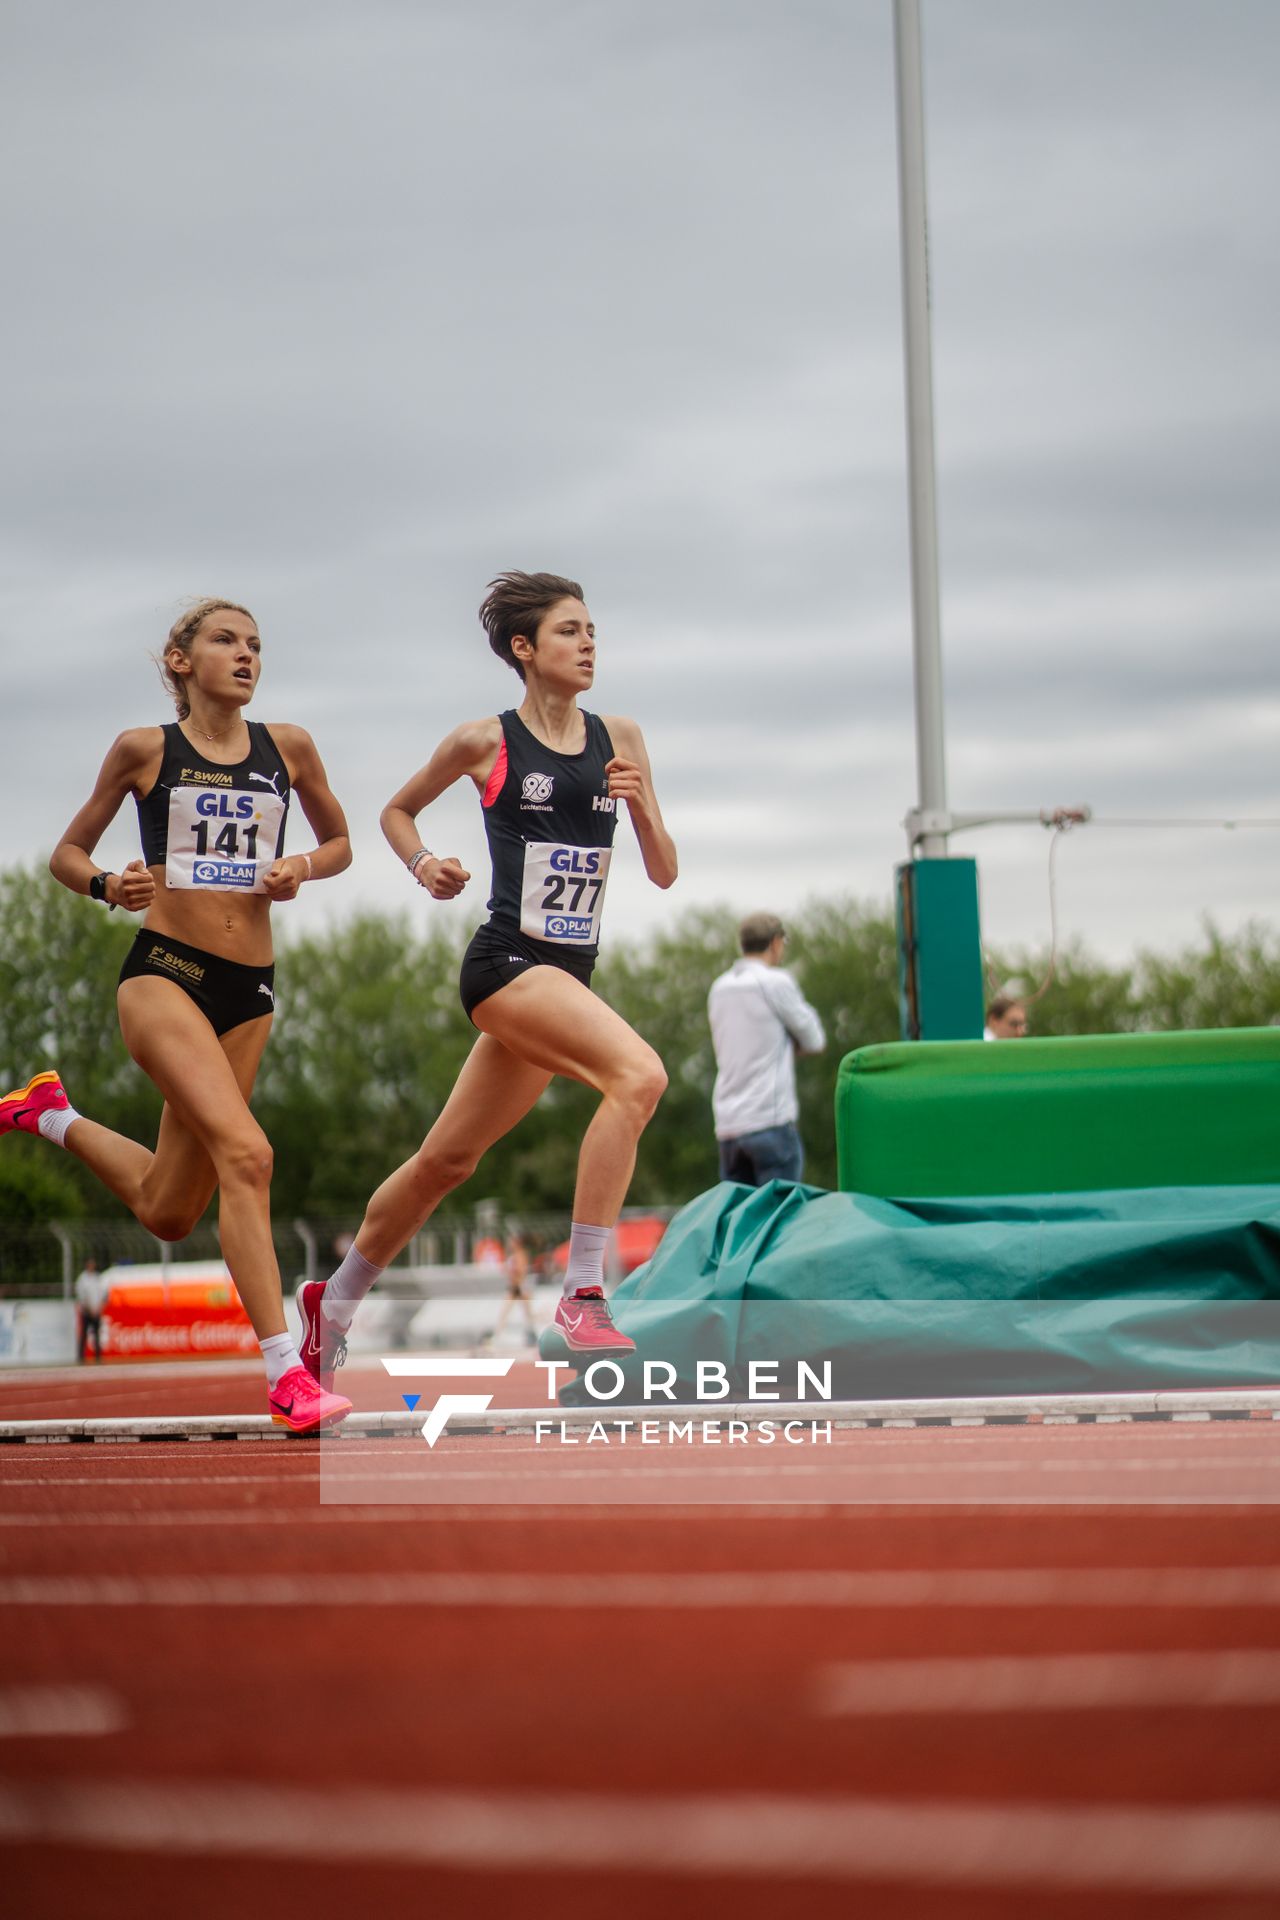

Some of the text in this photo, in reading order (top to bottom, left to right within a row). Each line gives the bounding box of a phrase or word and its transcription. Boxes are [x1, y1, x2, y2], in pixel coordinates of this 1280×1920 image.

[523, 776, 553, 799] 96
[190, 820, 259, 860] 141
[220, 866, 254, 879] PLAN
[541, 874, 604, 914] 277
